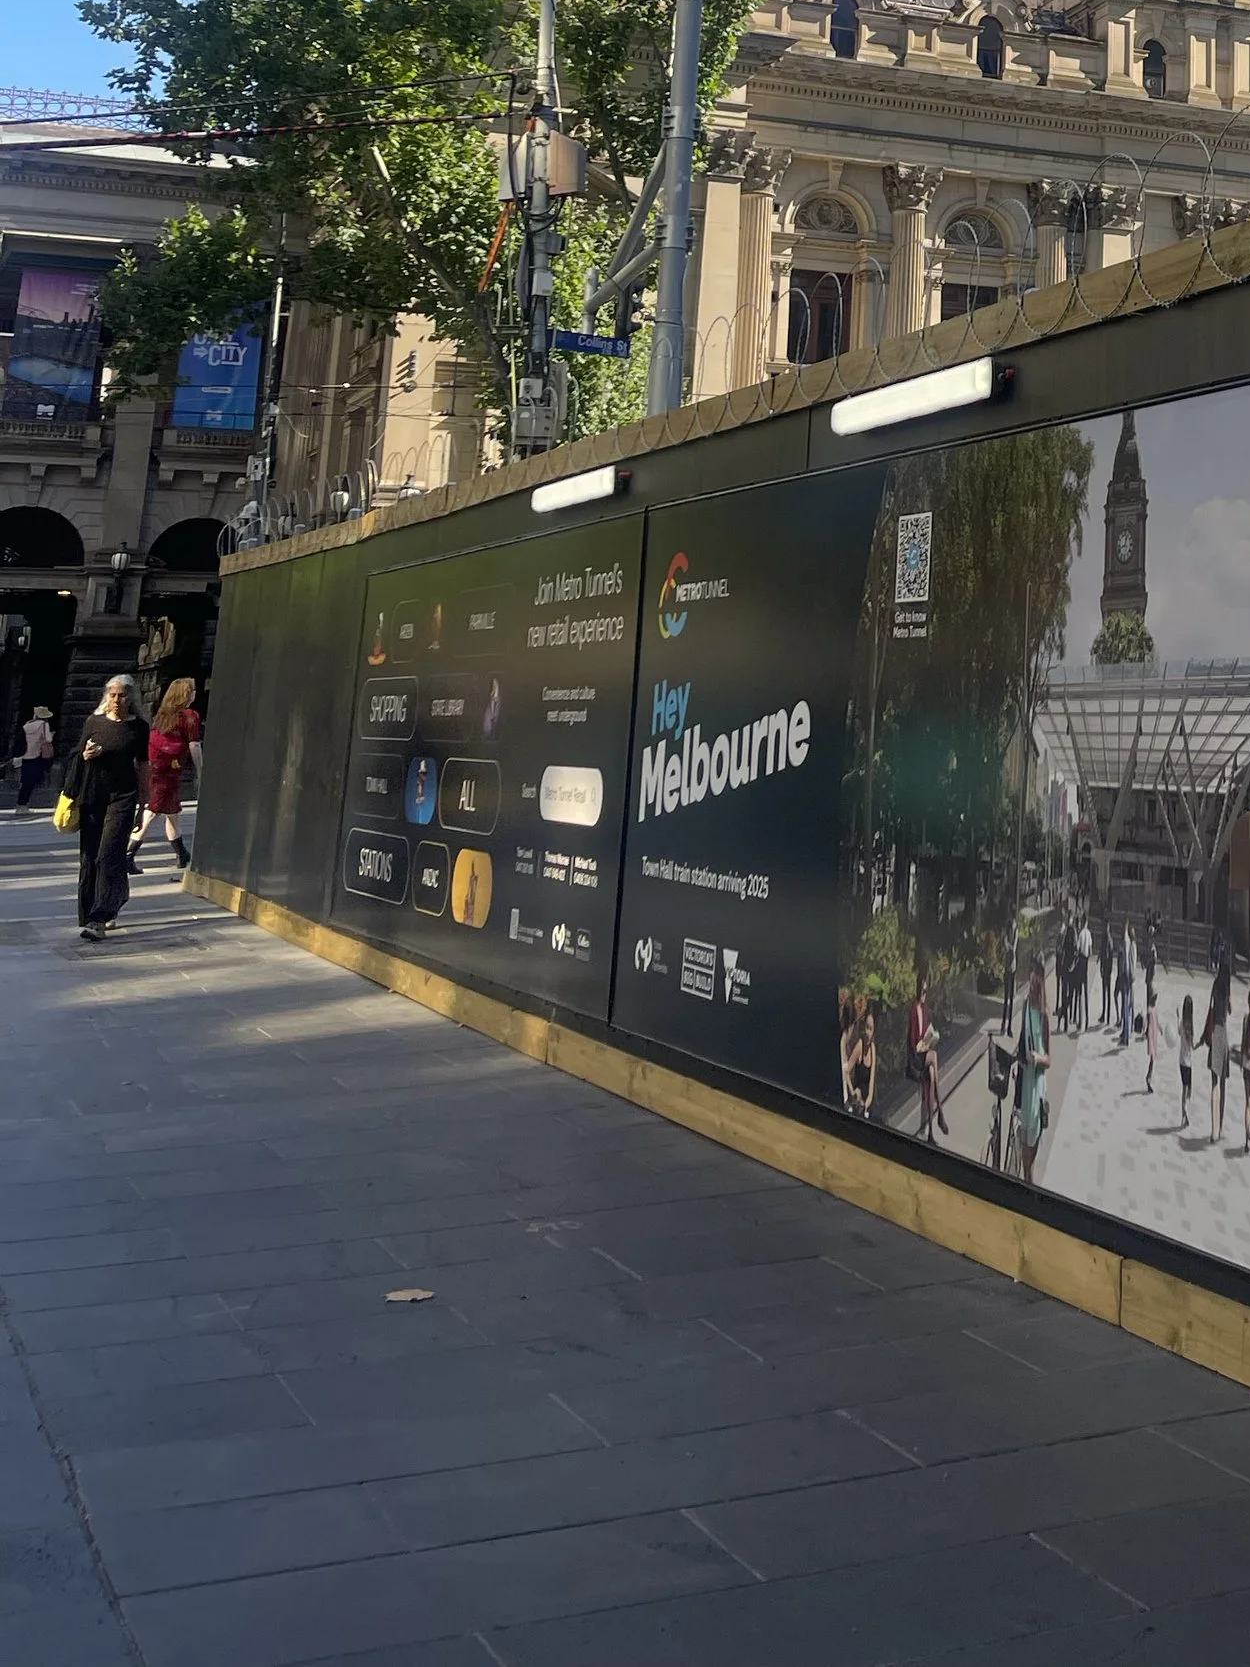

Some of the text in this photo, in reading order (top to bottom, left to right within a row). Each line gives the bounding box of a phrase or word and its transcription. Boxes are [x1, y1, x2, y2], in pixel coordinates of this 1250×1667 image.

[208, 344, 248, 366] CITY
[578, 335, 613, 350] Collins
[616, 340, 628, 352] St
[534, 575, 554, 605] Join
[554, 571, 582, 602] Metro
[675, 577, 730, 603] METROTUNNEL
[527, 612, 624, 651] new retail experience
[893, 625, 928, 638] Metro Tunnel
[894, 610, 905, 624] Get
[369, 694, 408, 723] SHOPPING
[652, 679, 691, 741] Hey
[638, 699, 812, 823] Melbourne
[458, 779, 476, 812] ALL
[358, 847, 394, 883] STATIONS
[642, 855, 769, 901] Town Hall train station arriving 2025
